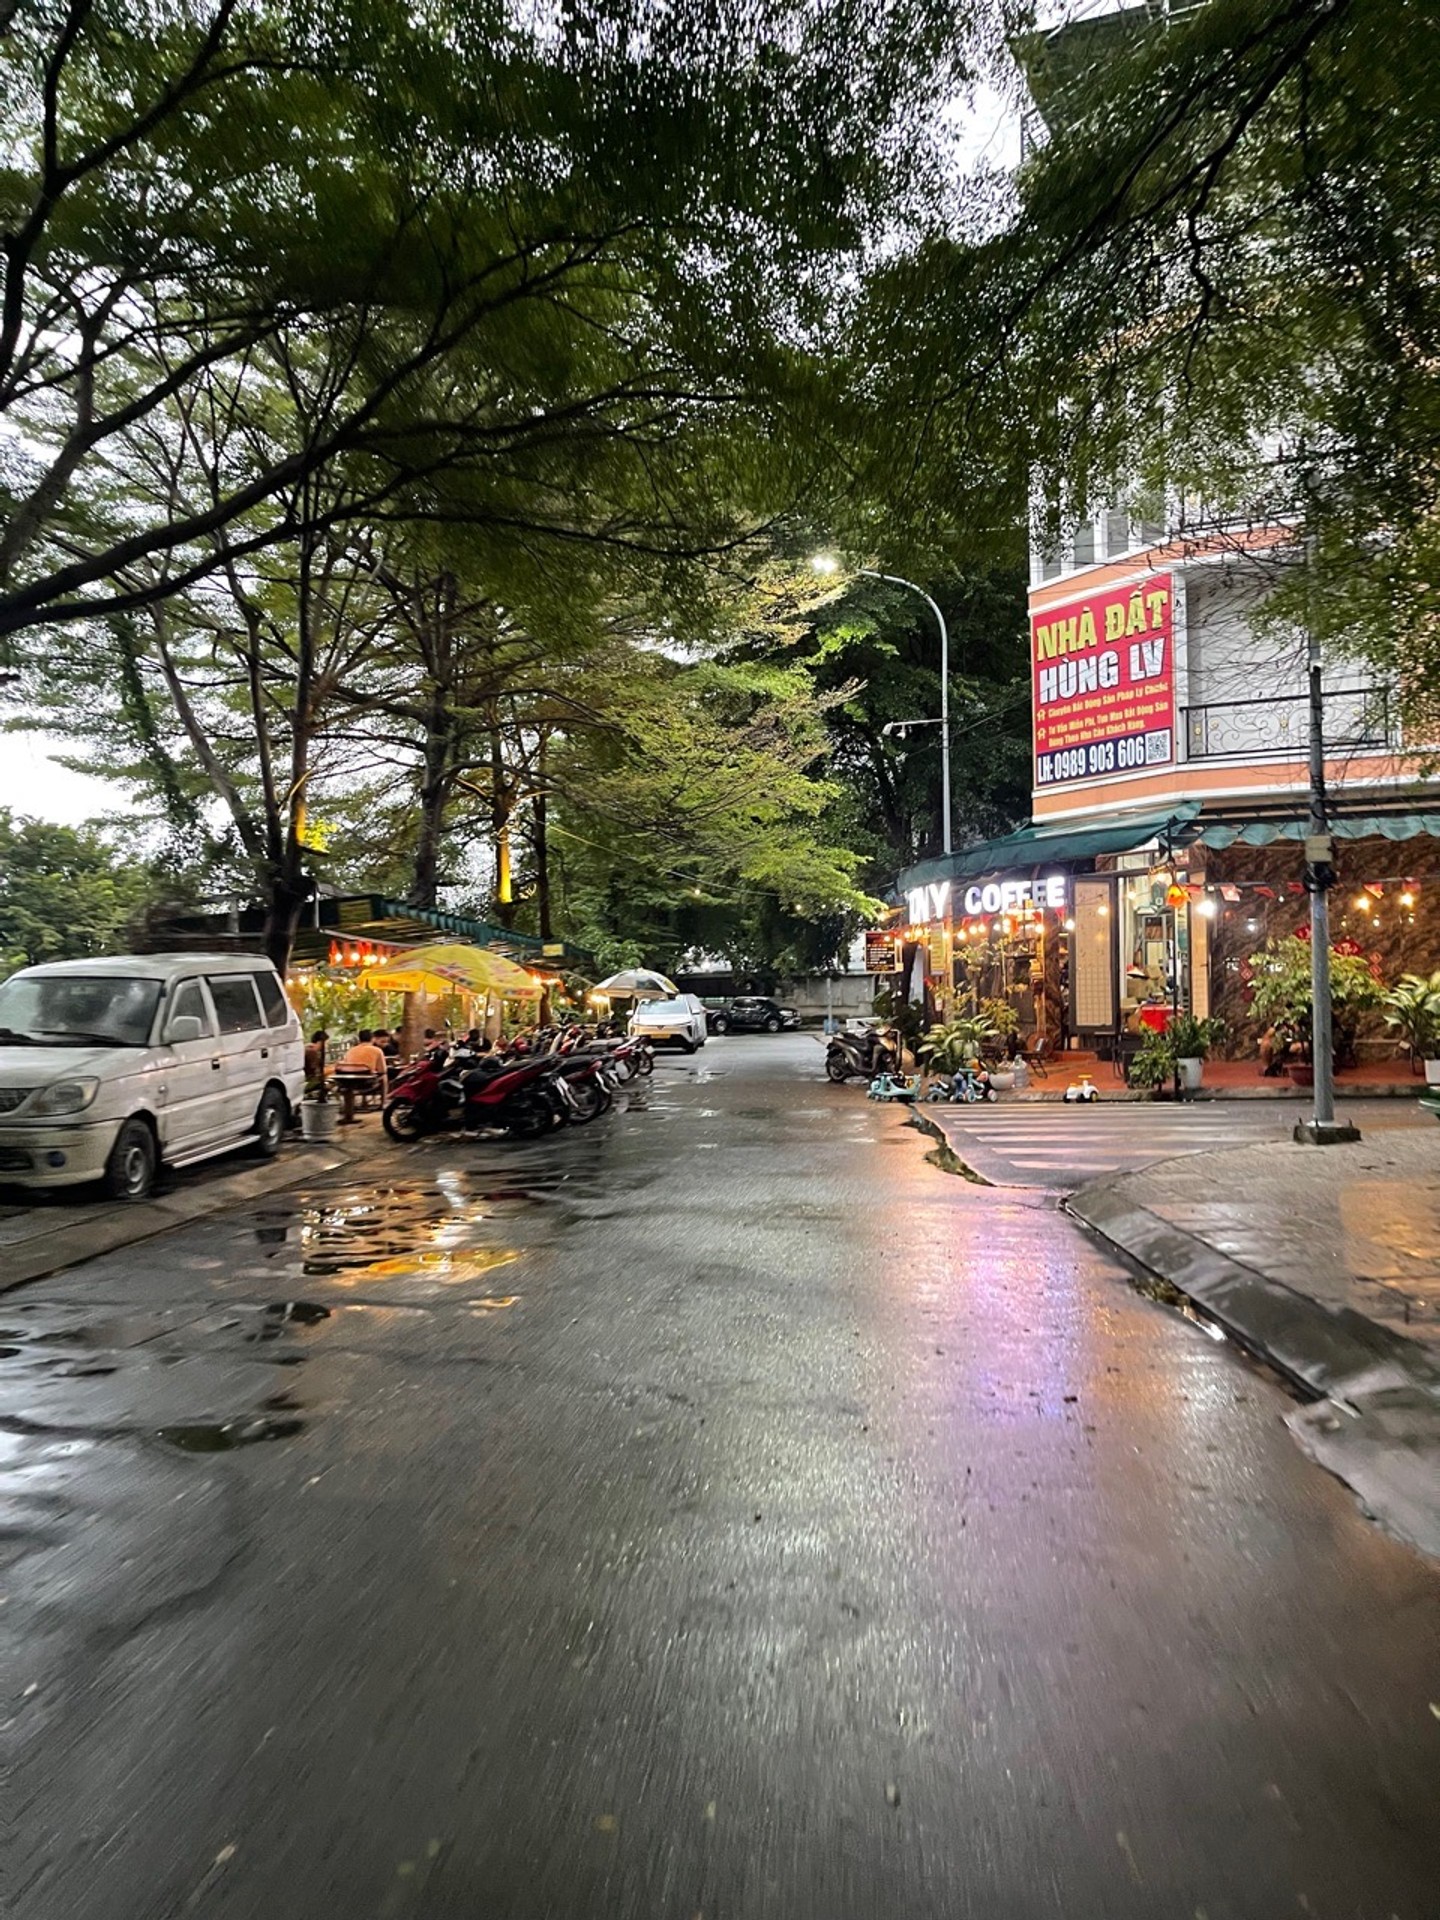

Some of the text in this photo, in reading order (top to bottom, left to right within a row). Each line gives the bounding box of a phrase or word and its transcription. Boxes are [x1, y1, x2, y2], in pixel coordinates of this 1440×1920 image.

[1036, 582, 1169, 661] NHÀ ĐẤT
[1039, 638, 1166, 704] HÙNG LV
[1038, 736, 1145, 783] LH: 0989 903 606
[964, 876, 1066, 914] COFFEE
